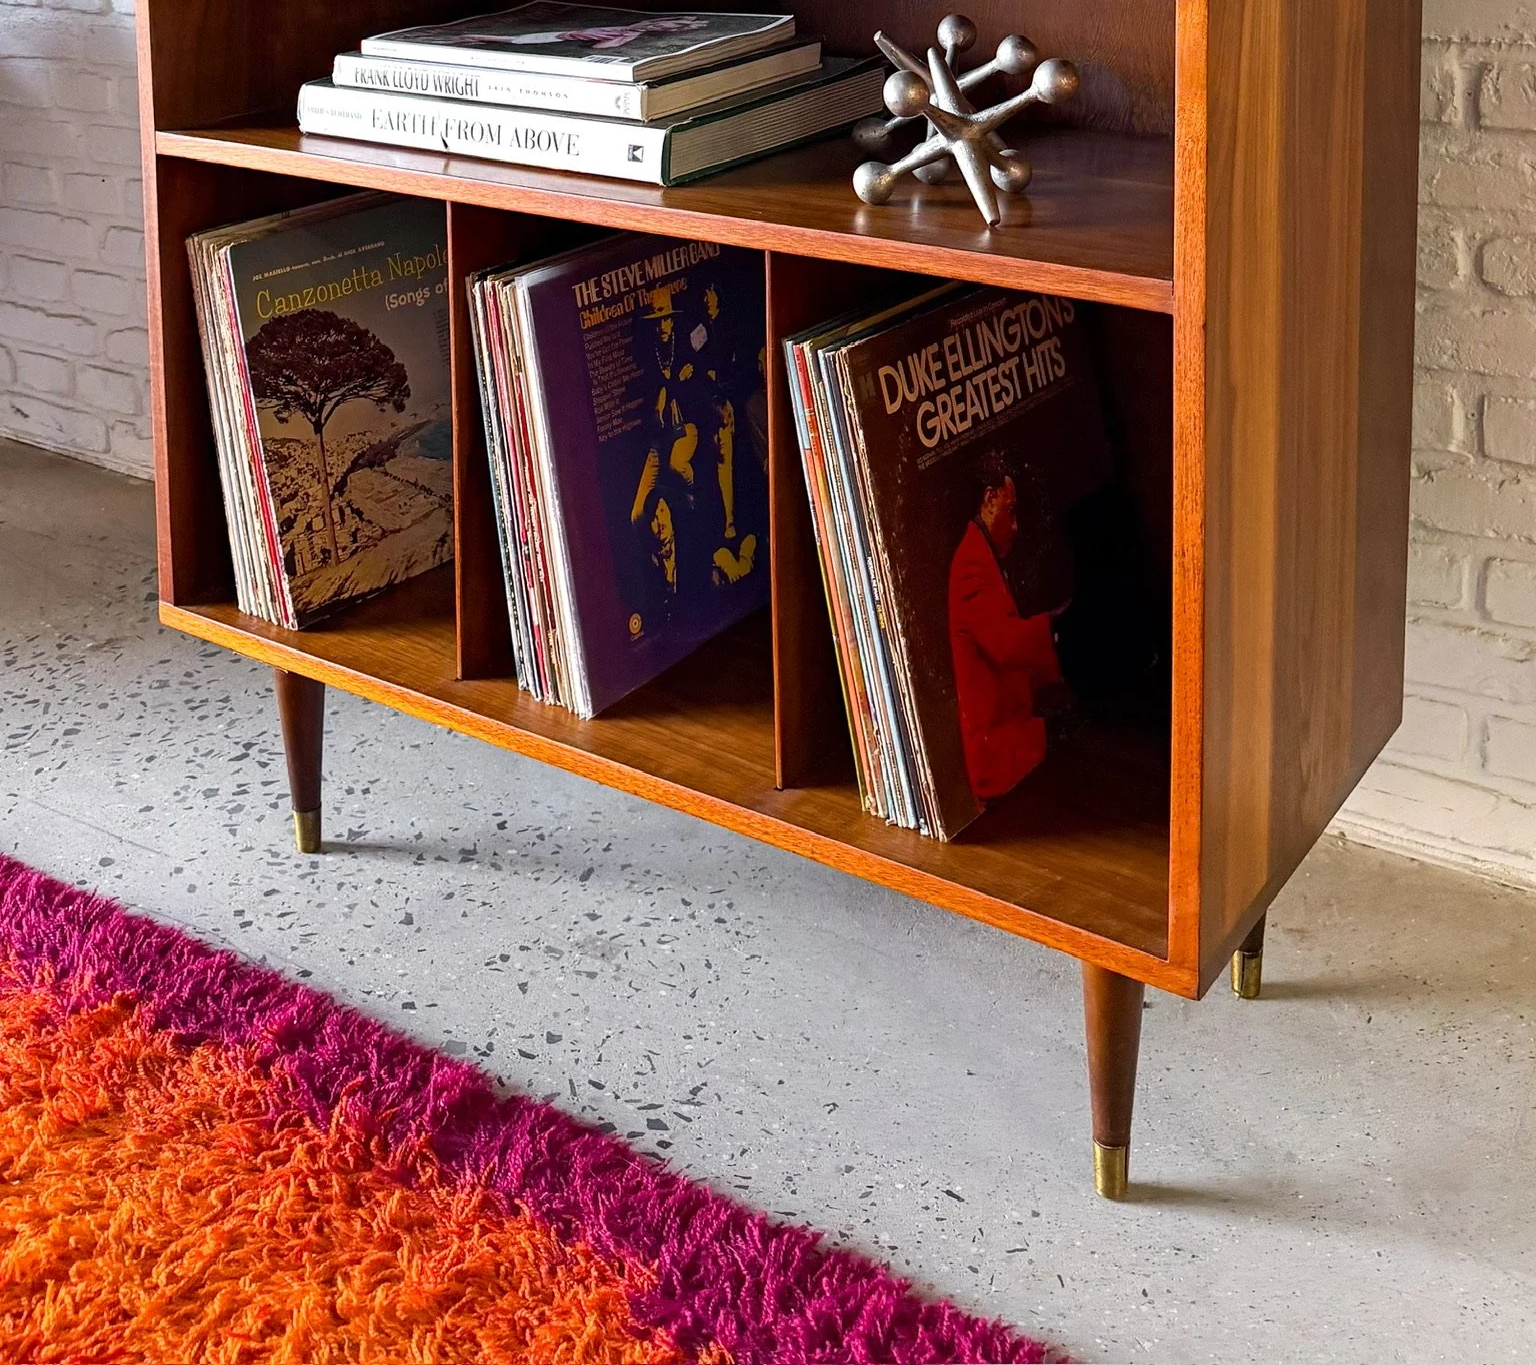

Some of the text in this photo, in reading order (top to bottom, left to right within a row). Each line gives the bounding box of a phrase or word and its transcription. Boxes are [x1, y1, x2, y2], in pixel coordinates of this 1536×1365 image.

[354, 66, 481, 98] FRANK LLOYD WRIGHT
[372, 108, 581, 157] EARTH FROM ABOVE
[256, 268, 384, 320] Canzonetta
[384, 285, 431, 311] (Songs
[571, 276, 602, 308] THE
[601, 260, 646, 298] STEVE
[644, 246, 690, 282] MILLER
[579, 302, 624, 330] Children
[877, 342, 946, 415] DUKE
[916, 356, 1022, 449] GREATEST
[1022, 336, 1066, 394] HITS
